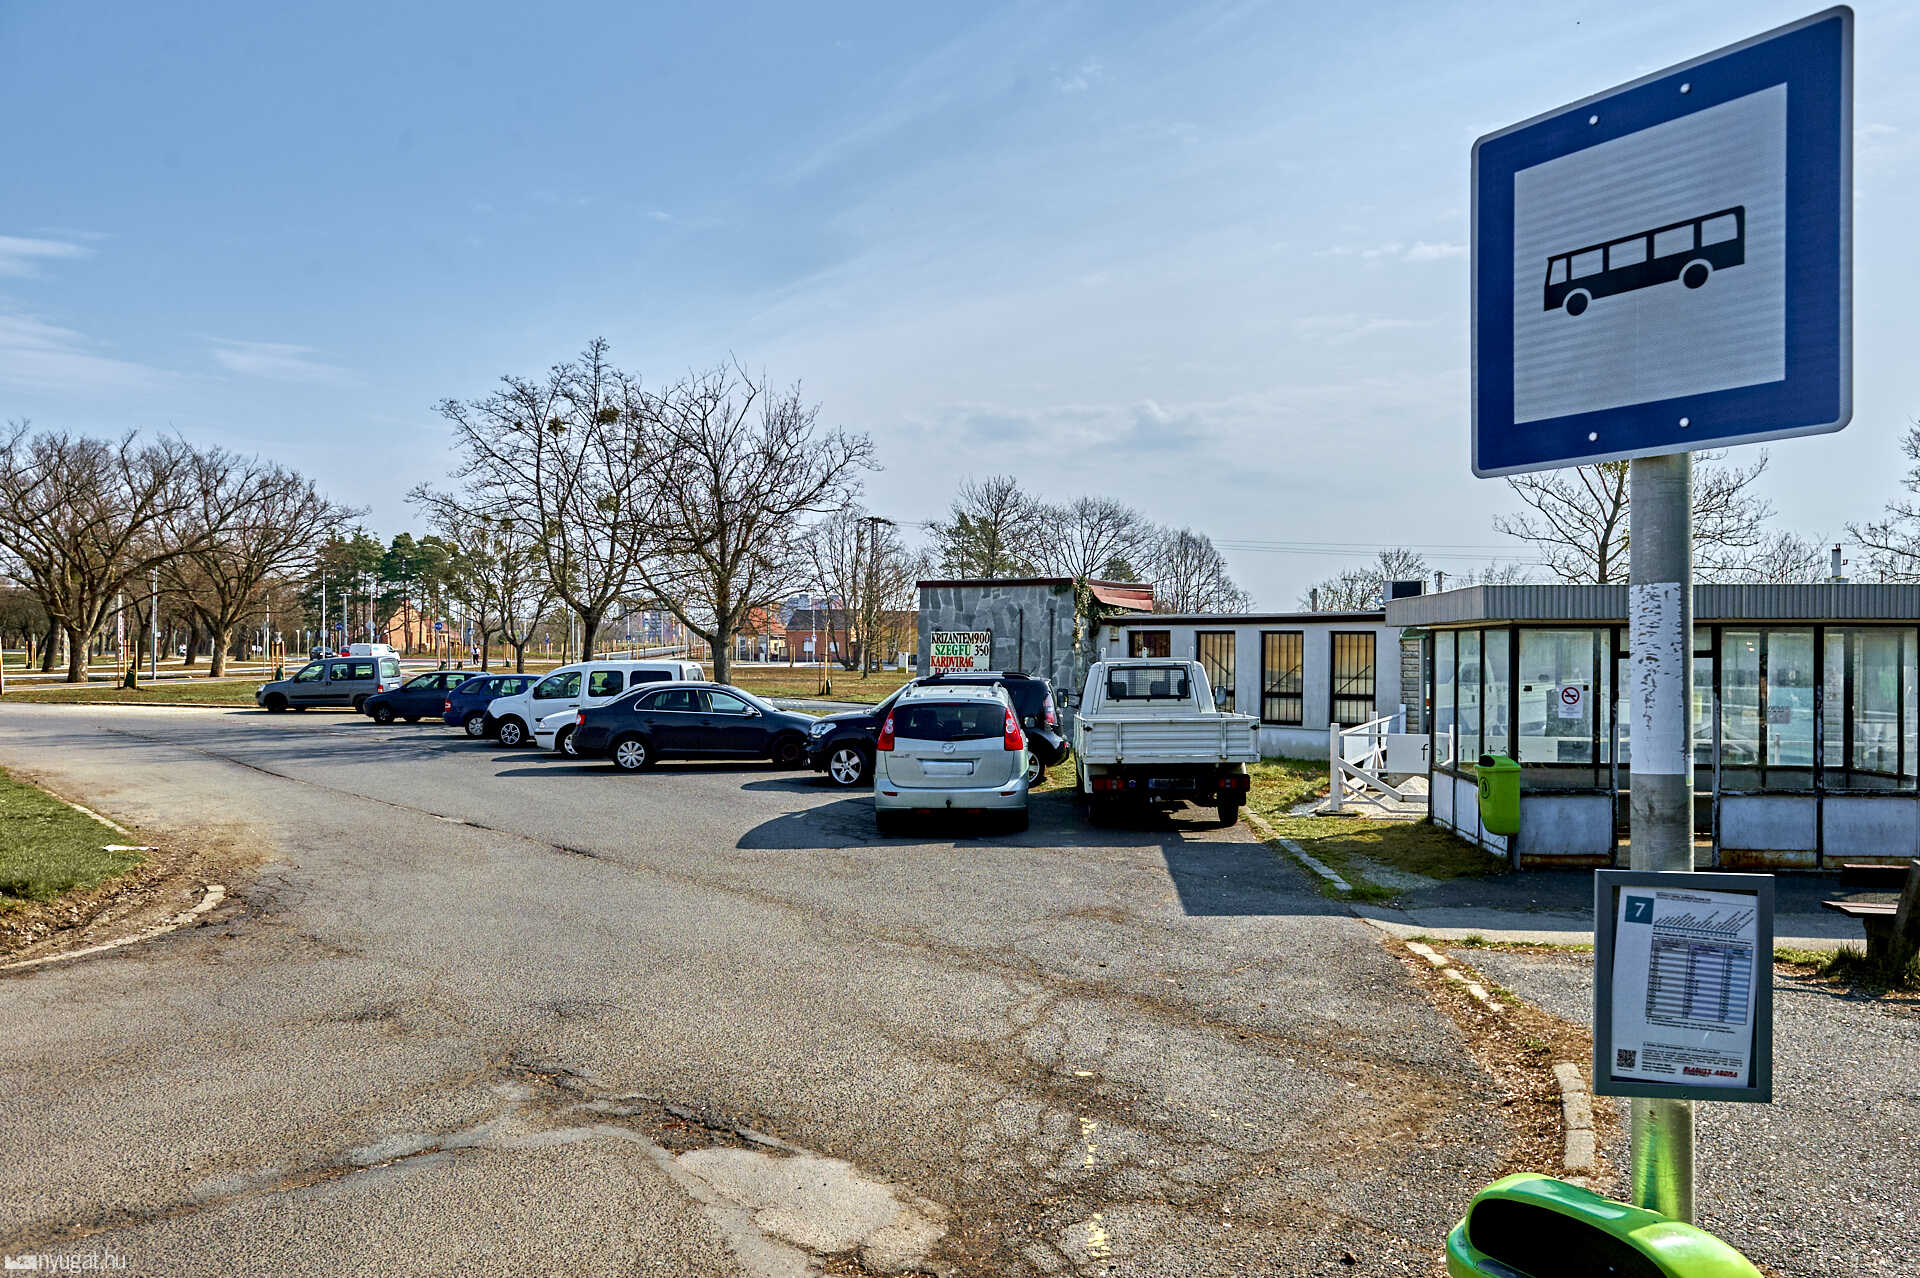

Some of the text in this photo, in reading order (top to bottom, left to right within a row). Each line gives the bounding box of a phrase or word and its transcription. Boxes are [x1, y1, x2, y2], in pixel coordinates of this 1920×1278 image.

[931, 632, 990, 644] KRIZANTEM 900
[974, 644, 989, 656] 350
[1635, 902, 1645, 917] 7
